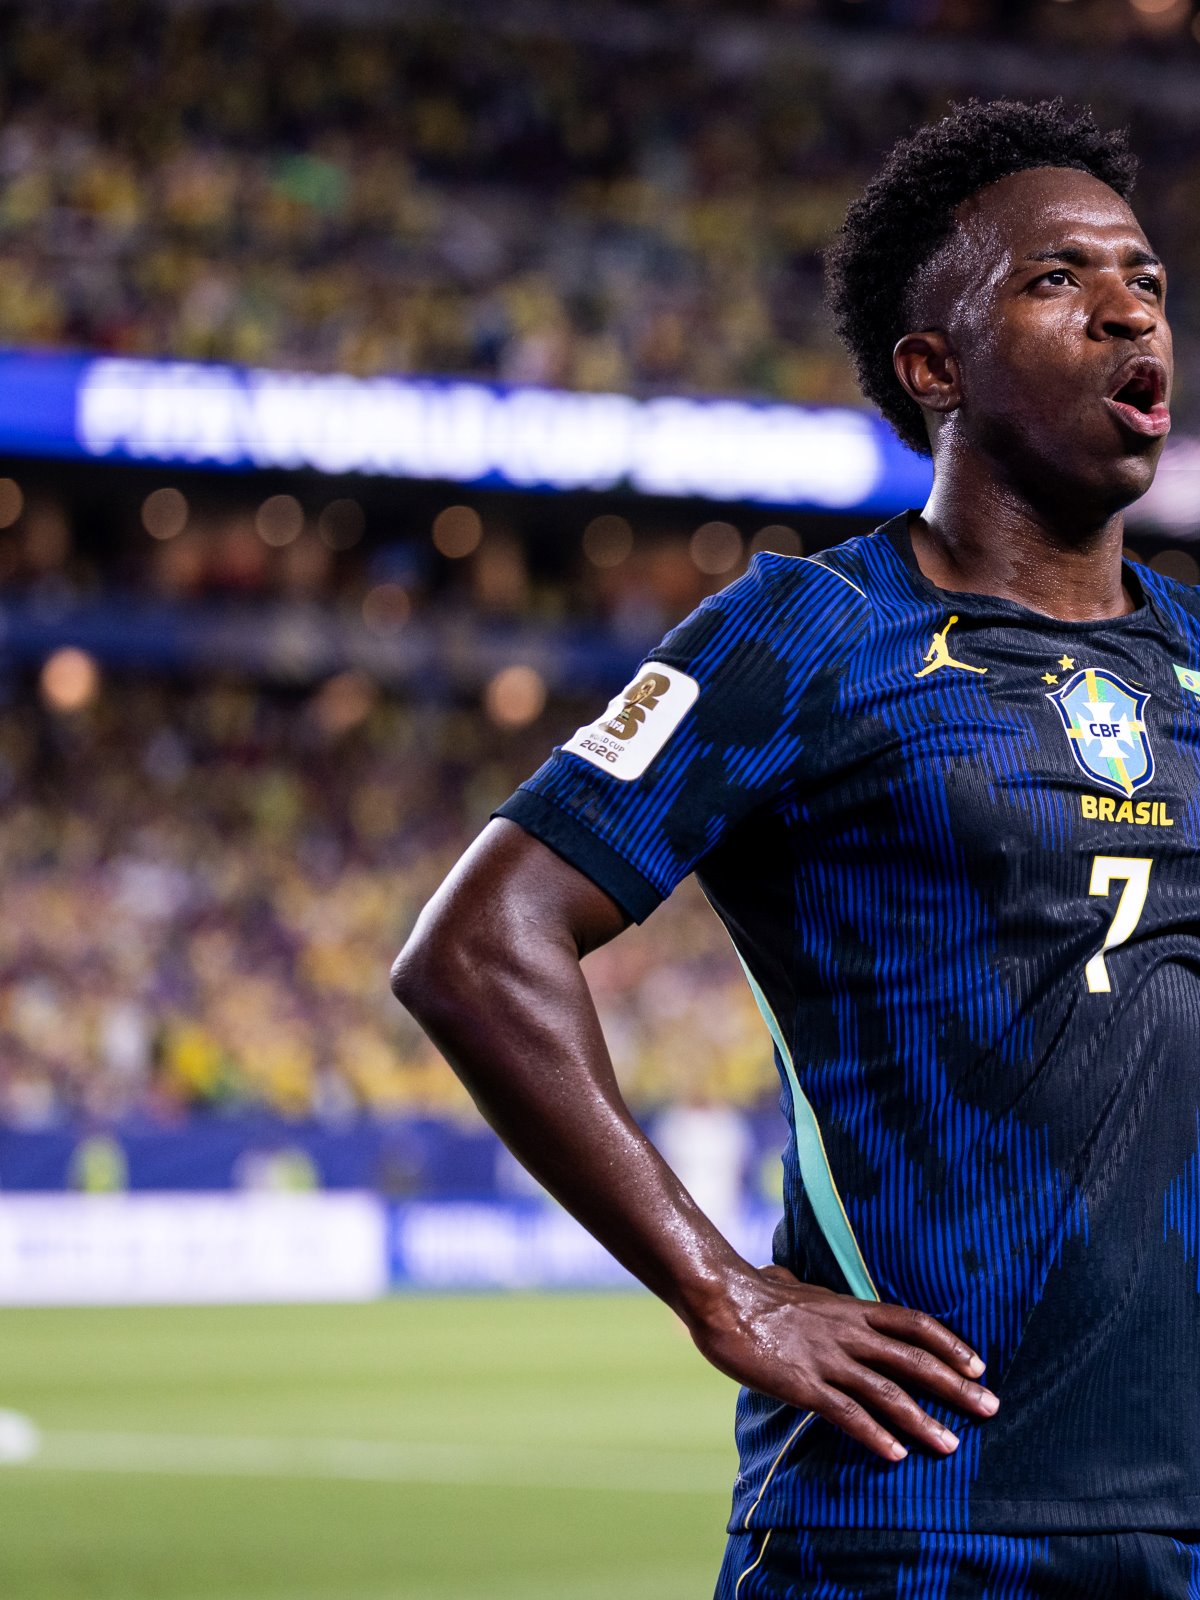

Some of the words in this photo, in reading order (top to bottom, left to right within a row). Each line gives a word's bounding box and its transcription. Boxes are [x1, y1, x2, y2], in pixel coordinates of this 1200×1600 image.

[1089, 723, 1121, 738] CBF
[579, 739, 619, 763] 2026
[609, 740, 625, 752] CUP
[1081, 795, 1174, 826] BRASIL
[1085, 856, 1153, 993] 7
